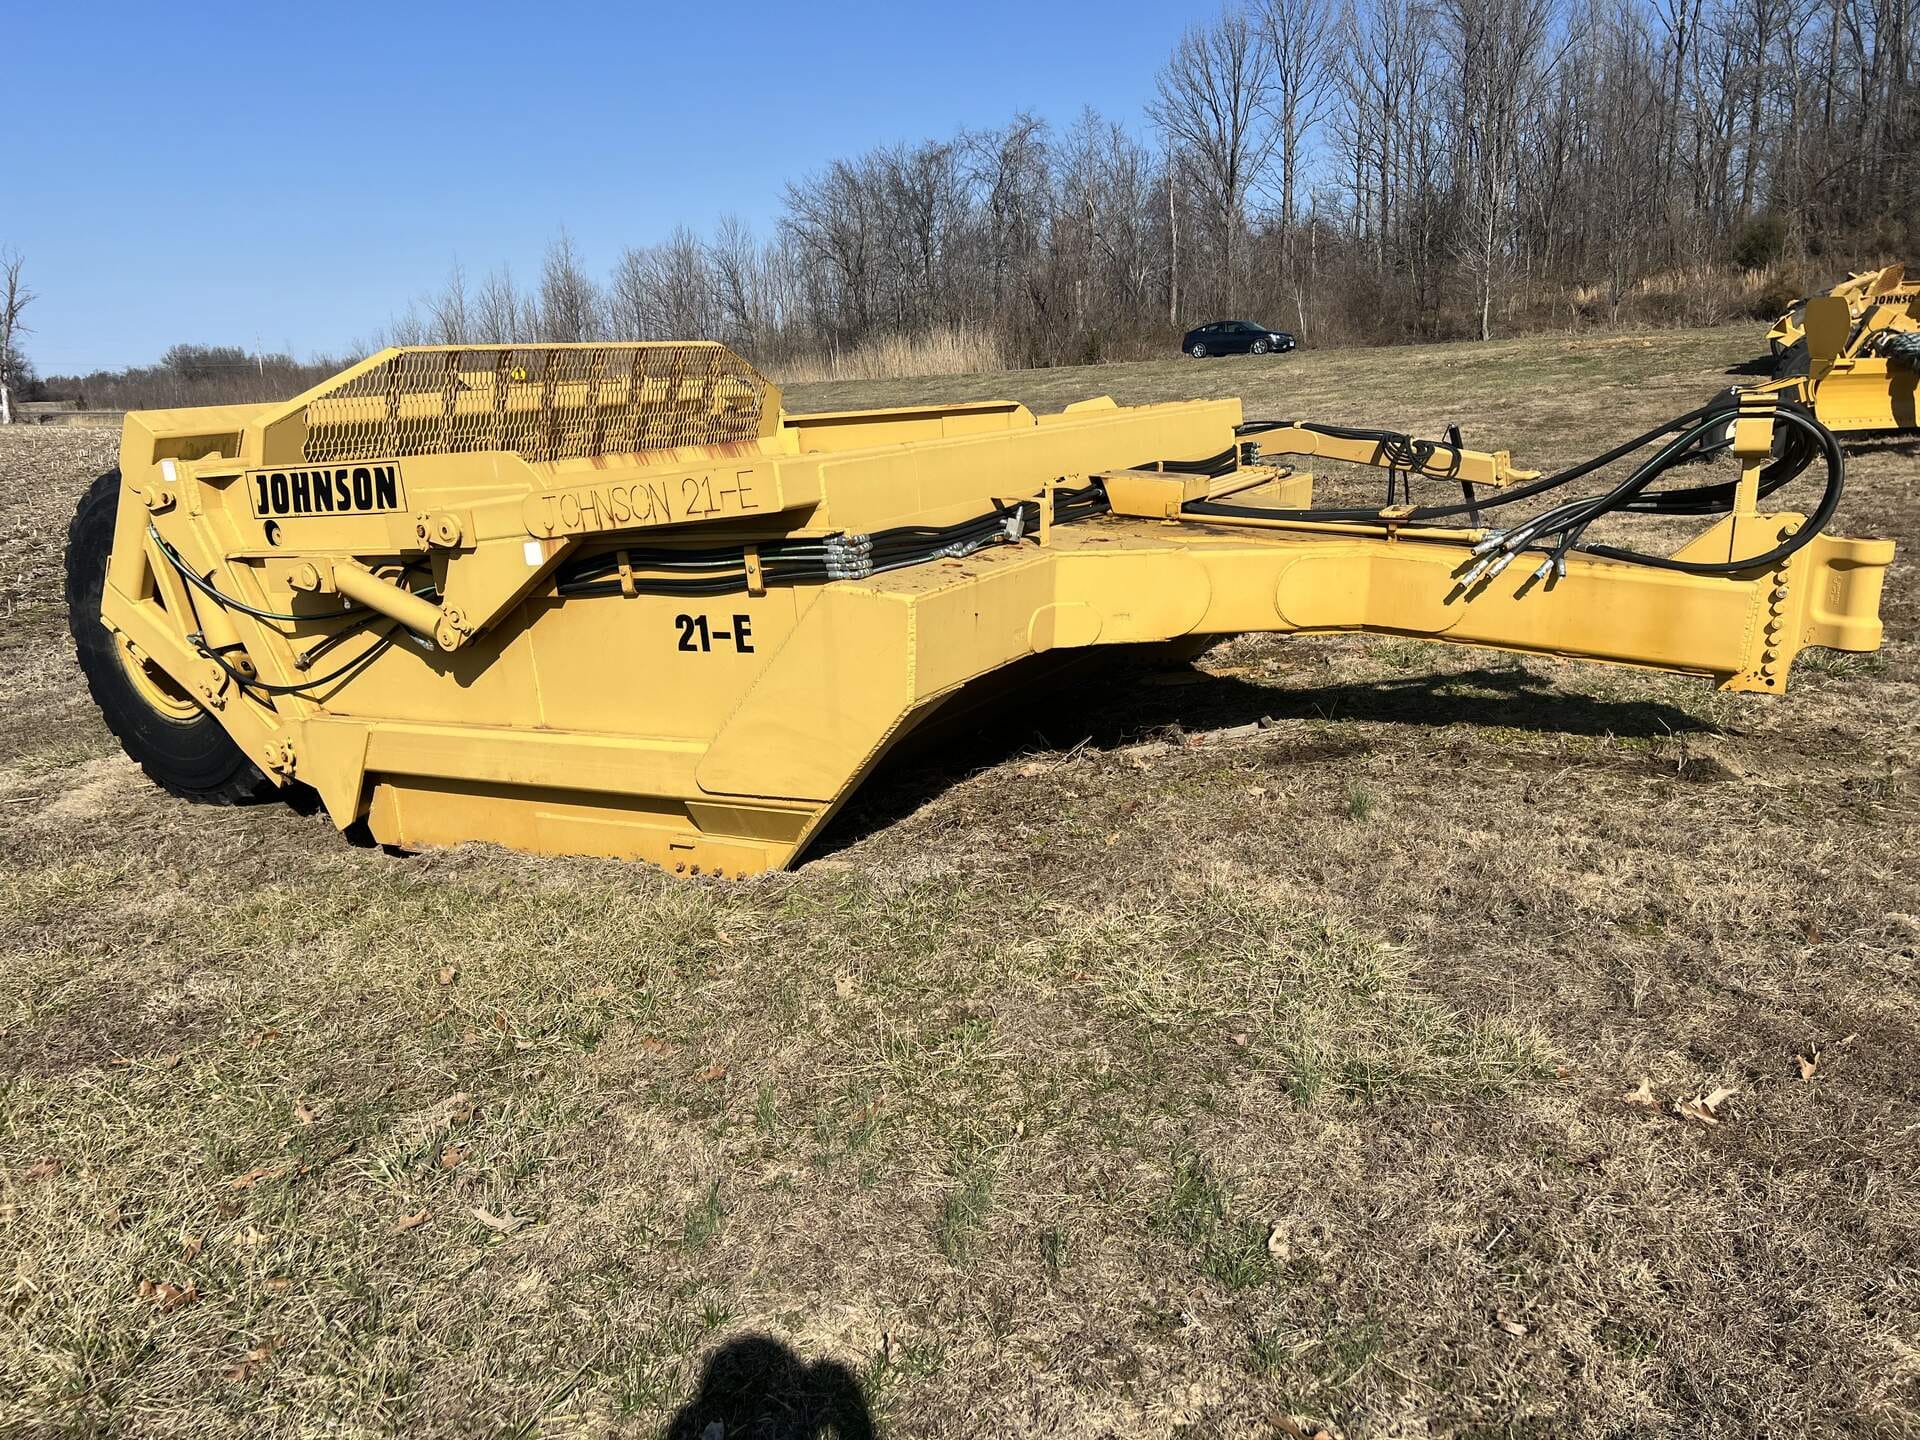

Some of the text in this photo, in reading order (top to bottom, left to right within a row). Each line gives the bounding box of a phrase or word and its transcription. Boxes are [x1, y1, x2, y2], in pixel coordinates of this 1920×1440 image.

[256, 466, 397, 515] JOHNSON
[542, 470, 759, 531] JOHNSON 21-E
[675, 613, 755, 653] 21-E
